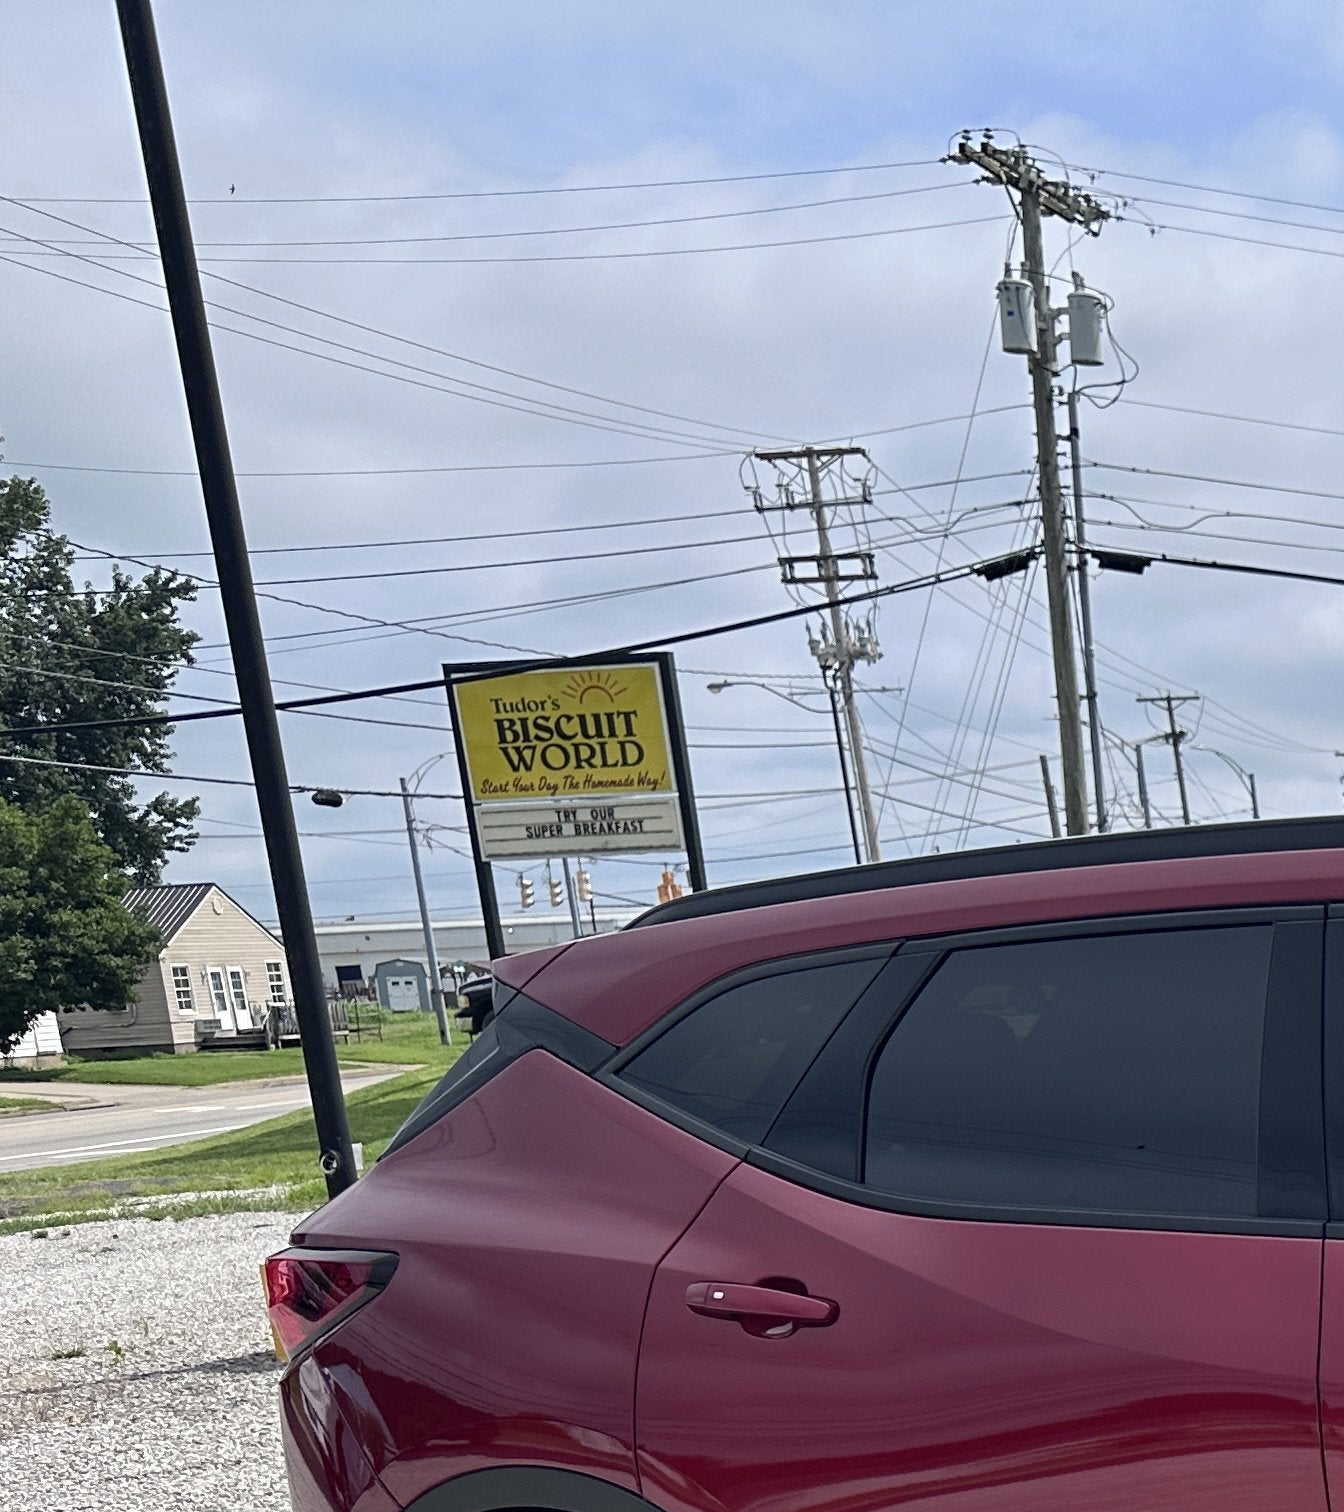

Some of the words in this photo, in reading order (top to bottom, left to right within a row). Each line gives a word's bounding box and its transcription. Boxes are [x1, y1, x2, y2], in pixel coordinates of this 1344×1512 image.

[490, 695, 561, 715] Tudor's
[494, 710, 638, 745] BISCUIT
[499, 740, 645, 773] WORLD
[480, 779, 510, 795] Start
[512, 776, 535, 793] Your
[538, 776, 559, 796] Day
[563, 775, 580, 790] The
[582, 774, 635, 790] Homemade
[637, 770, 667, 792] Way!
[555, 809, 578, 823] TRY
[591, 807, 615, 820] OUR
[526, 824, 564, 838] SUPER
[574, 820, 645, 836] BREAKFAST
